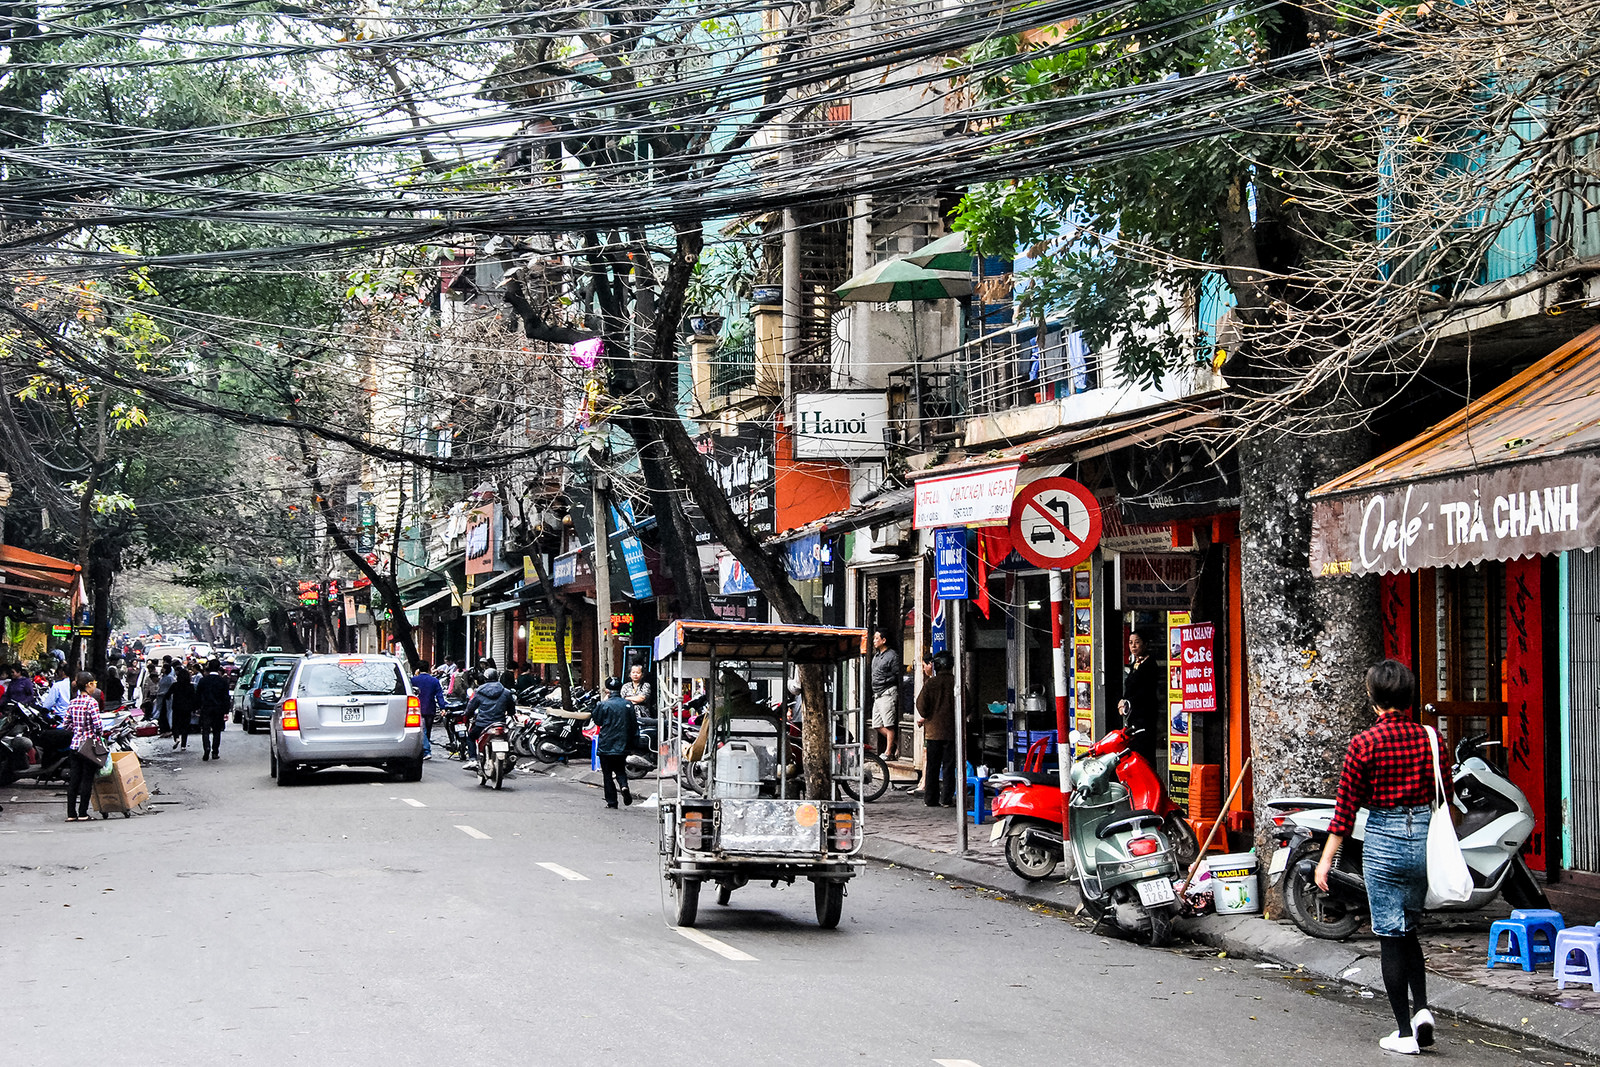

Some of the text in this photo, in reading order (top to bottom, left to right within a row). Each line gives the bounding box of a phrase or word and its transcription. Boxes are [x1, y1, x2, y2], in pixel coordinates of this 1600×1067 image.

[799, 411, 867, 434] Hanoi
[950, 483, 985, 501] CHICKEN
[988, 479, 1014, 497] KEBAB
[1148, 492, 1174, 509] Coffee
[1359, 484, 1579, 570] Café TRÀ CHANH
[1124, 558, 1191, 580] BOOKING OFFICE
[1185, 683, 1198, 693] HOA
[1217, 868, 1249, 878] MAXILITE
[1143, 880, 1167, 894] 30-F1
[1146, 890, 1170, 903] 1262
